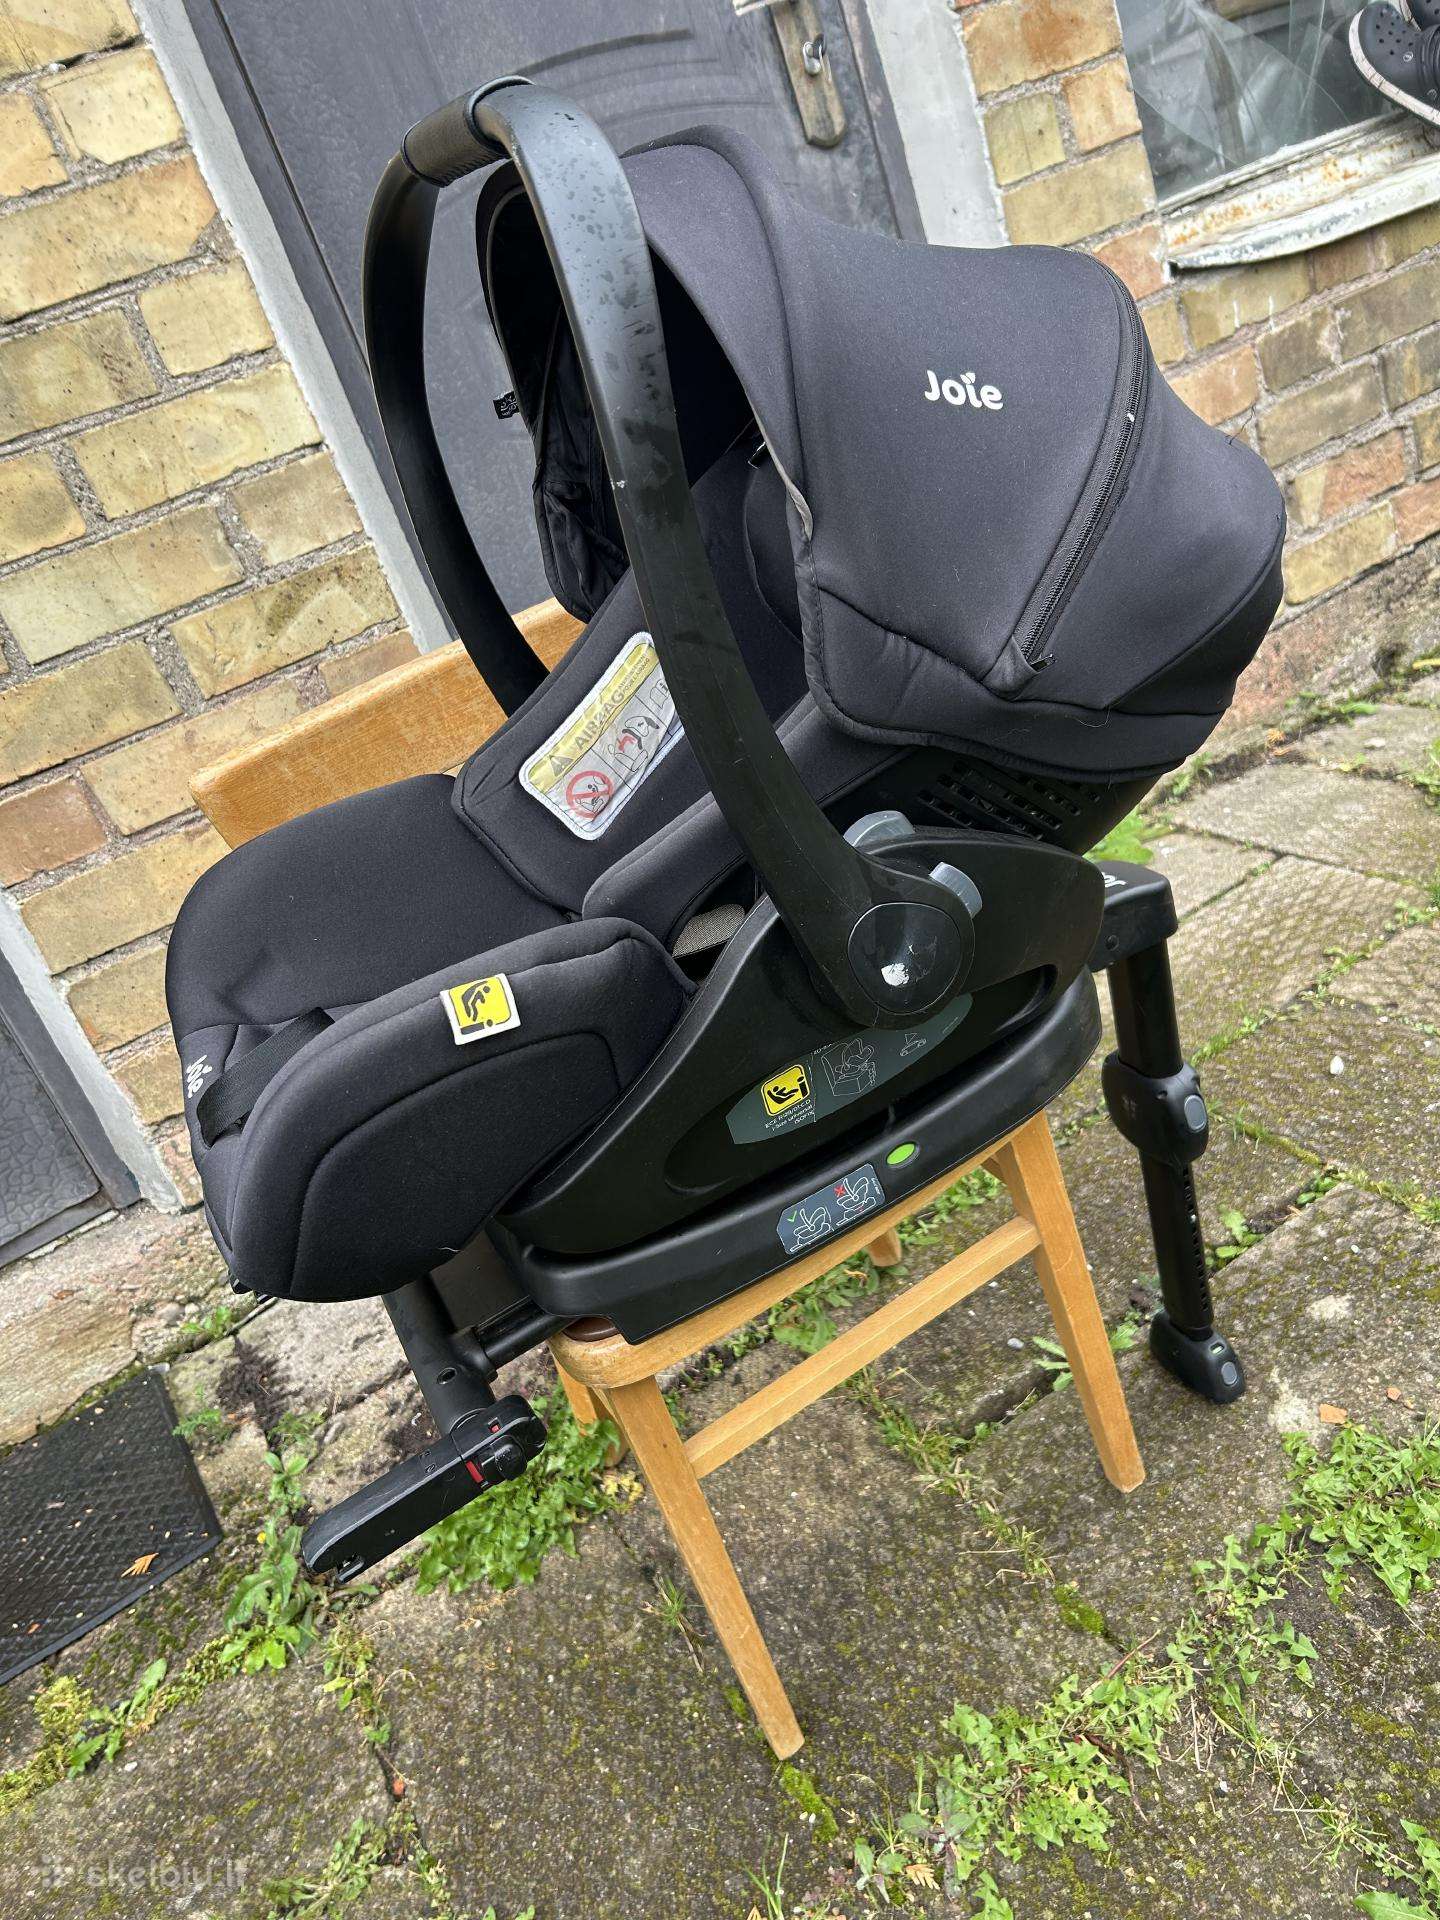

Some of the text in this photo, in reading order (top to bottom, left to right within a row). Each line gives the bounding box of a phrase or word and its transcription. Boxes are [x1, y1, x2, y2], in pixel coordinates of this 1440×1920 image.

[924, 369, 1004, 410] Joie
[575, 689, 625, 751] AIRBAG
[186, 1054, 213, 1099] Joie
